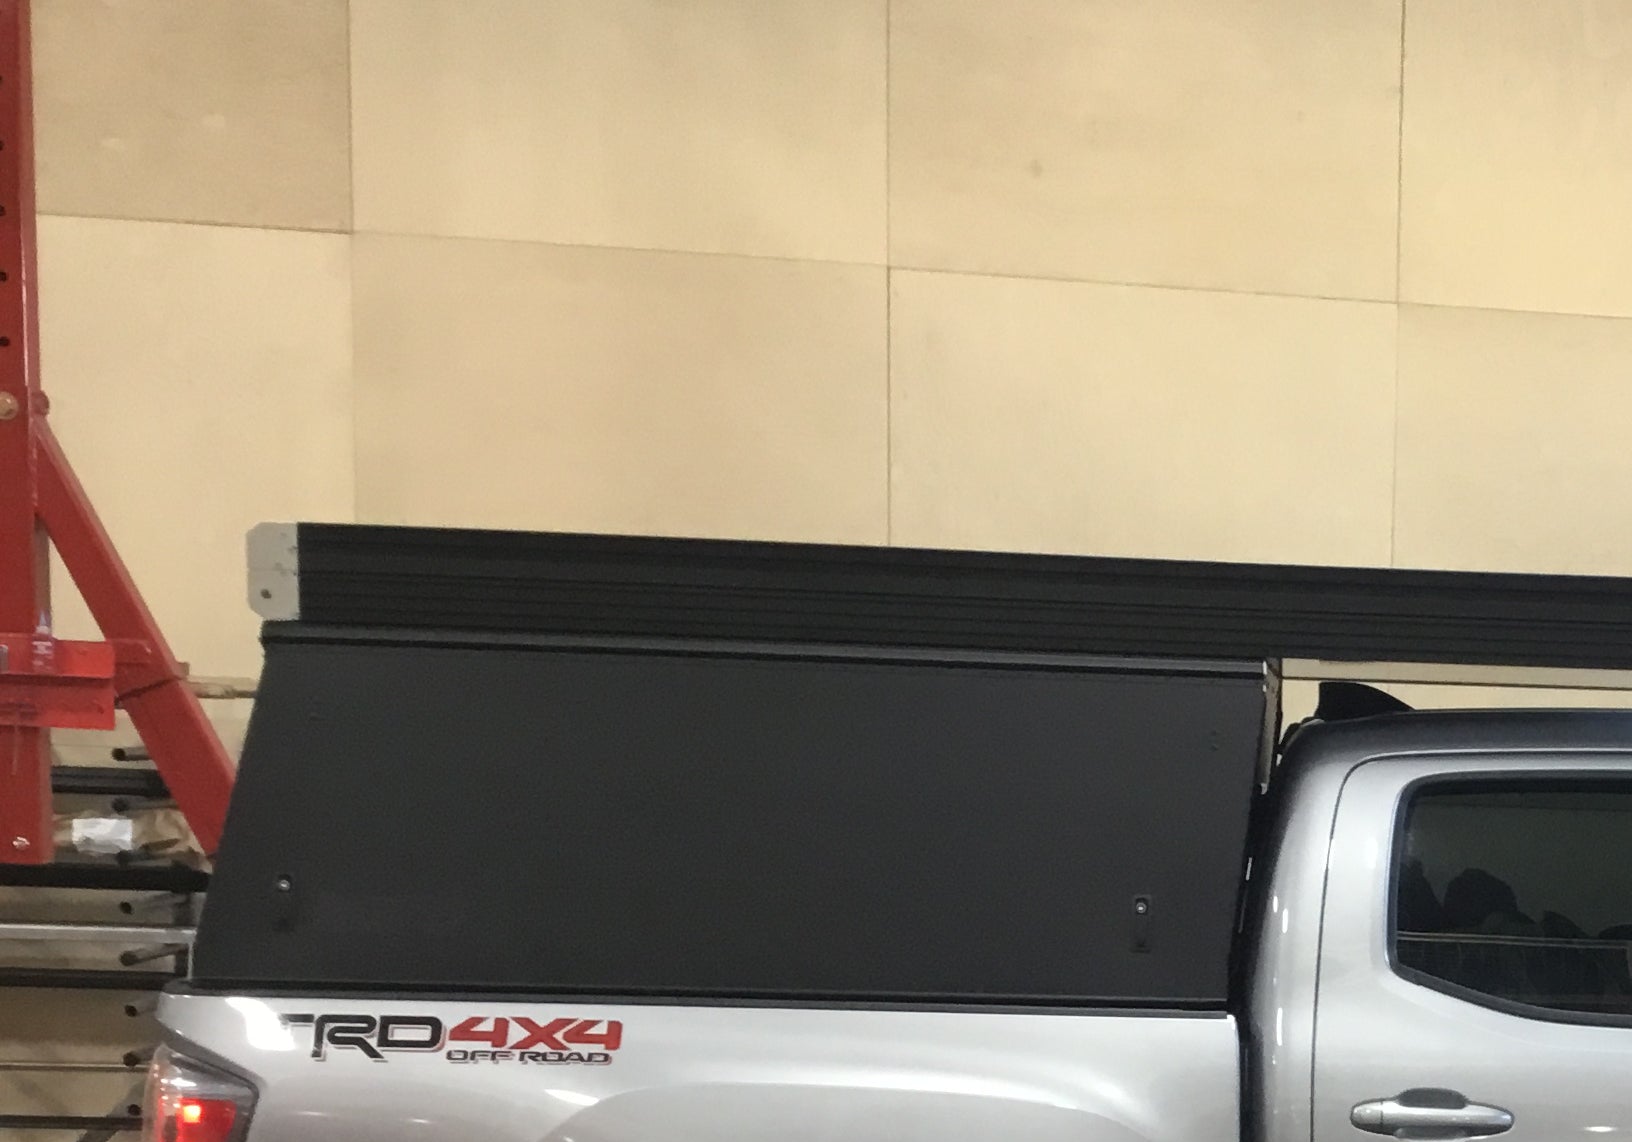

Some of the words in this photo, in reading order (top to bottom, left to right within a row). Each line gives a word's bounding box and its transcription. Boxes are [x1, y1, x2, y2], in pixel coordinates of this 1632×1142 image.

[280, 1013, 443, 1061] TRD
[446, 1049, 512, 1063] OFF
[518, 1050, 612, 1065] ROAD
